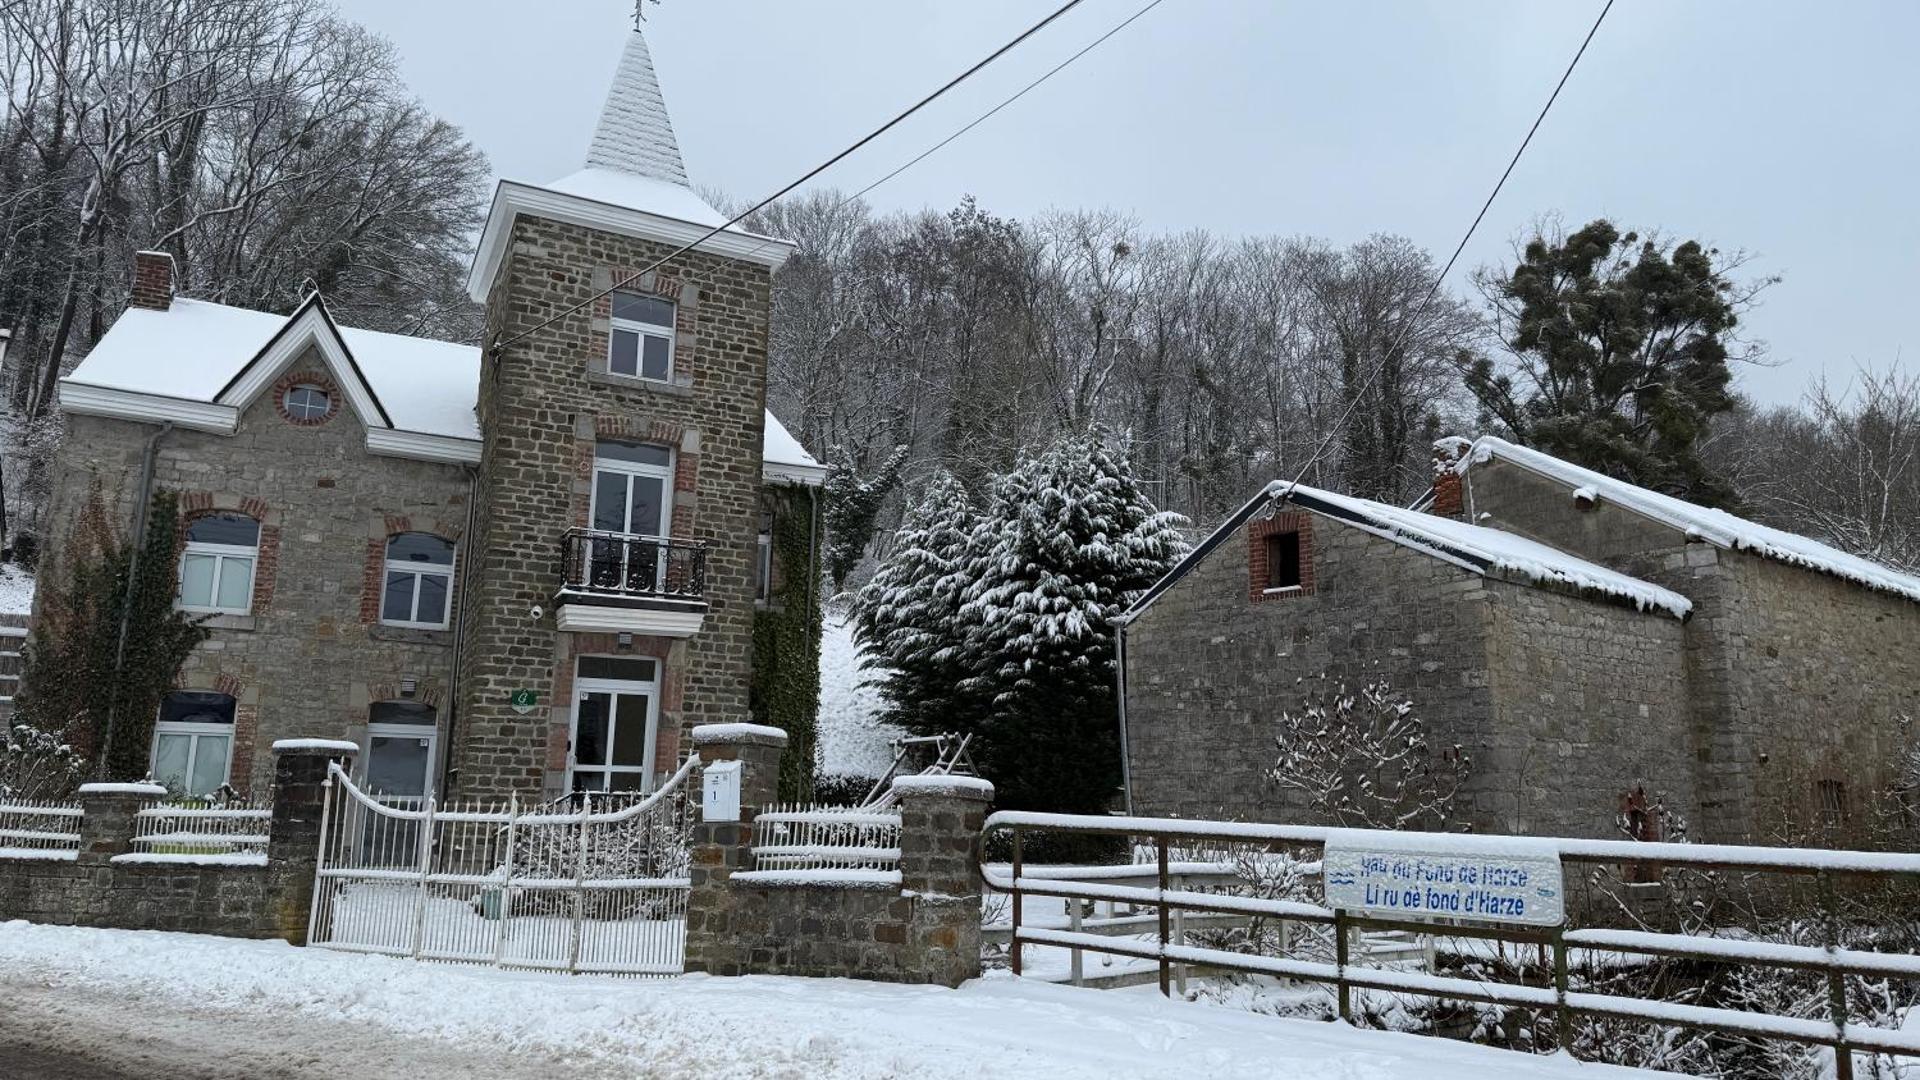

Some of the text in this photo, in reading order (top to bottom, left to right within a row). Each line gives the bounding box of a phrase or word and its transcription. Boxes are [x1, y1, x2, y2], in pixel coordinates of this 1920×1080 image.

[1366, 883, 1379, 905] Li
[1383, 889, 1398, 906] ru
[1426, 887, 1459, 911] fond
